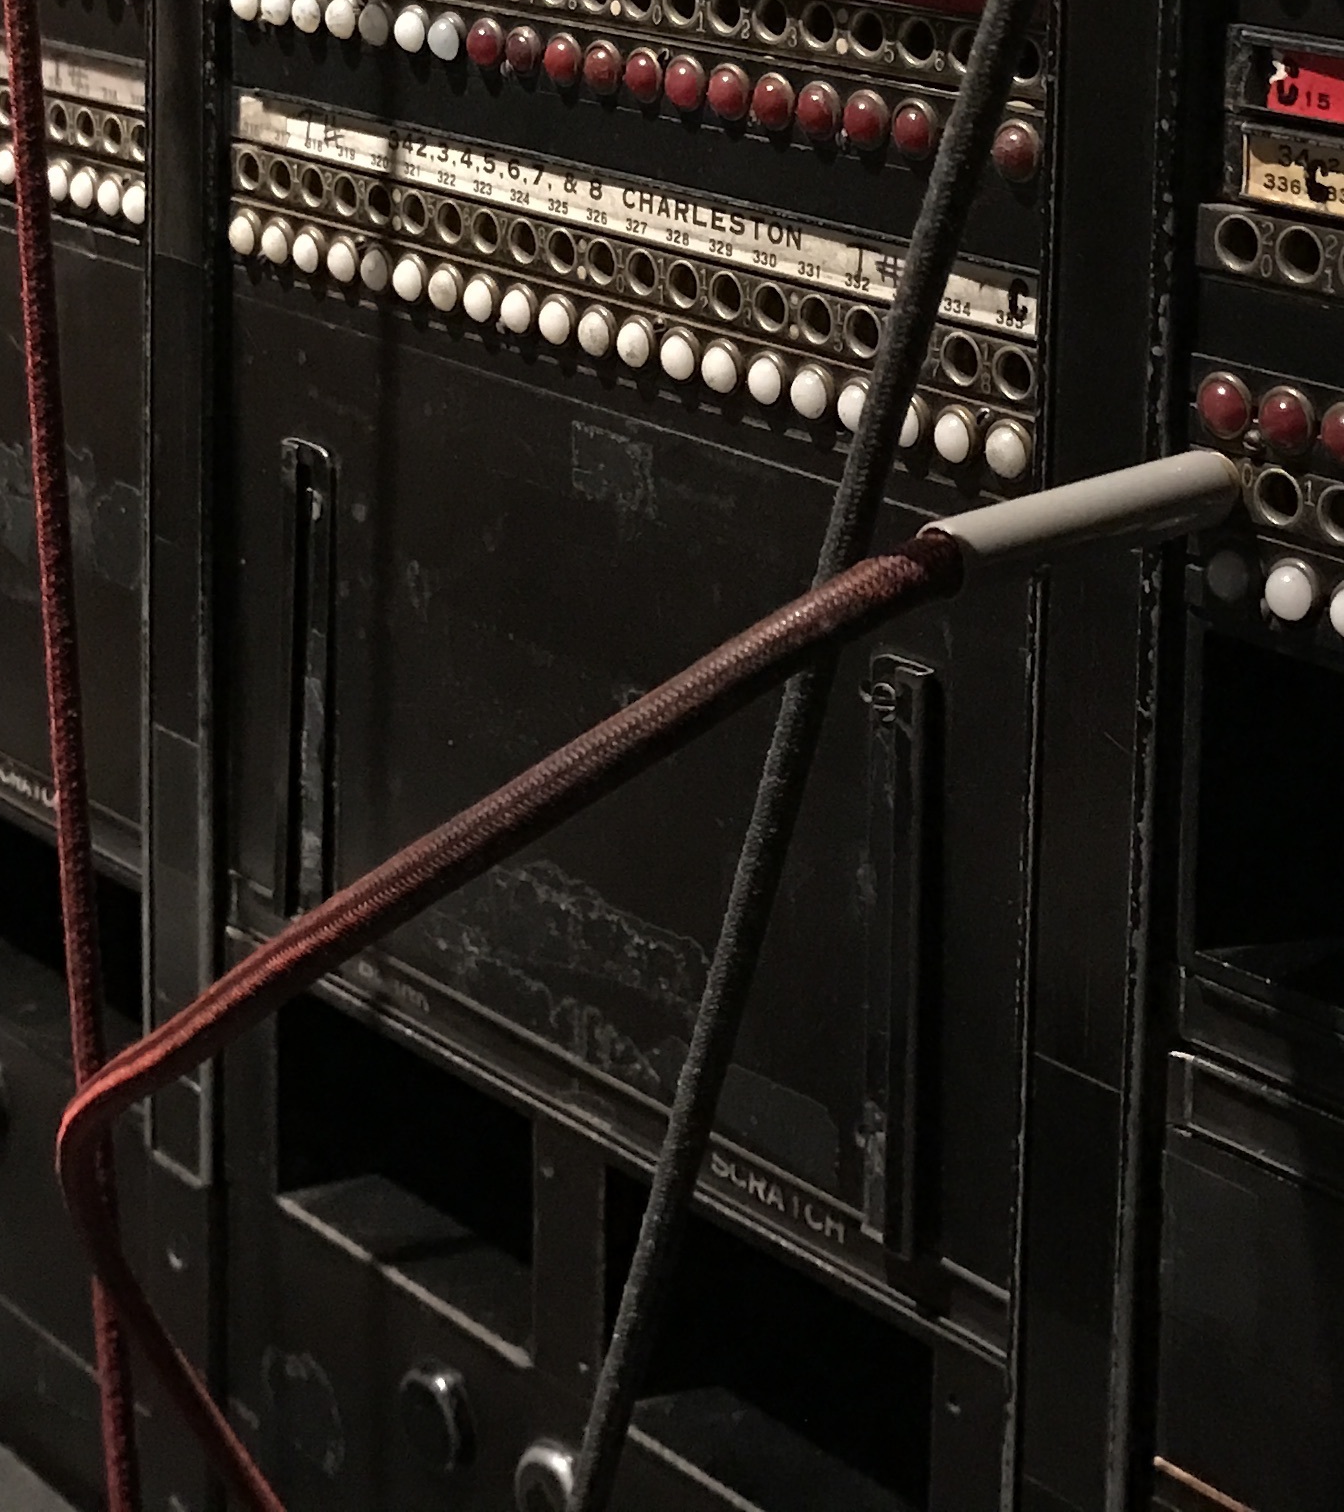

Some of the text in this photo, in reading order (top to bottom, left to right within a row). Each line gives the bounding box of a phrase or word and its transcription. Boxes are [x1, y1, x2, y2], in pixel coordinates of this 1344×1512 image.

[1305, 91, 1331, 111] 15
[1262, 172, 1300, 196] 336
[563, 170, 578, 195] &
[589, 178, 604, 200] 8
[622, 187, 803, 251] CHARLESTON
[437, 169, 971, 317] 322 323 324 325 326 327 328 329 330 331 334
